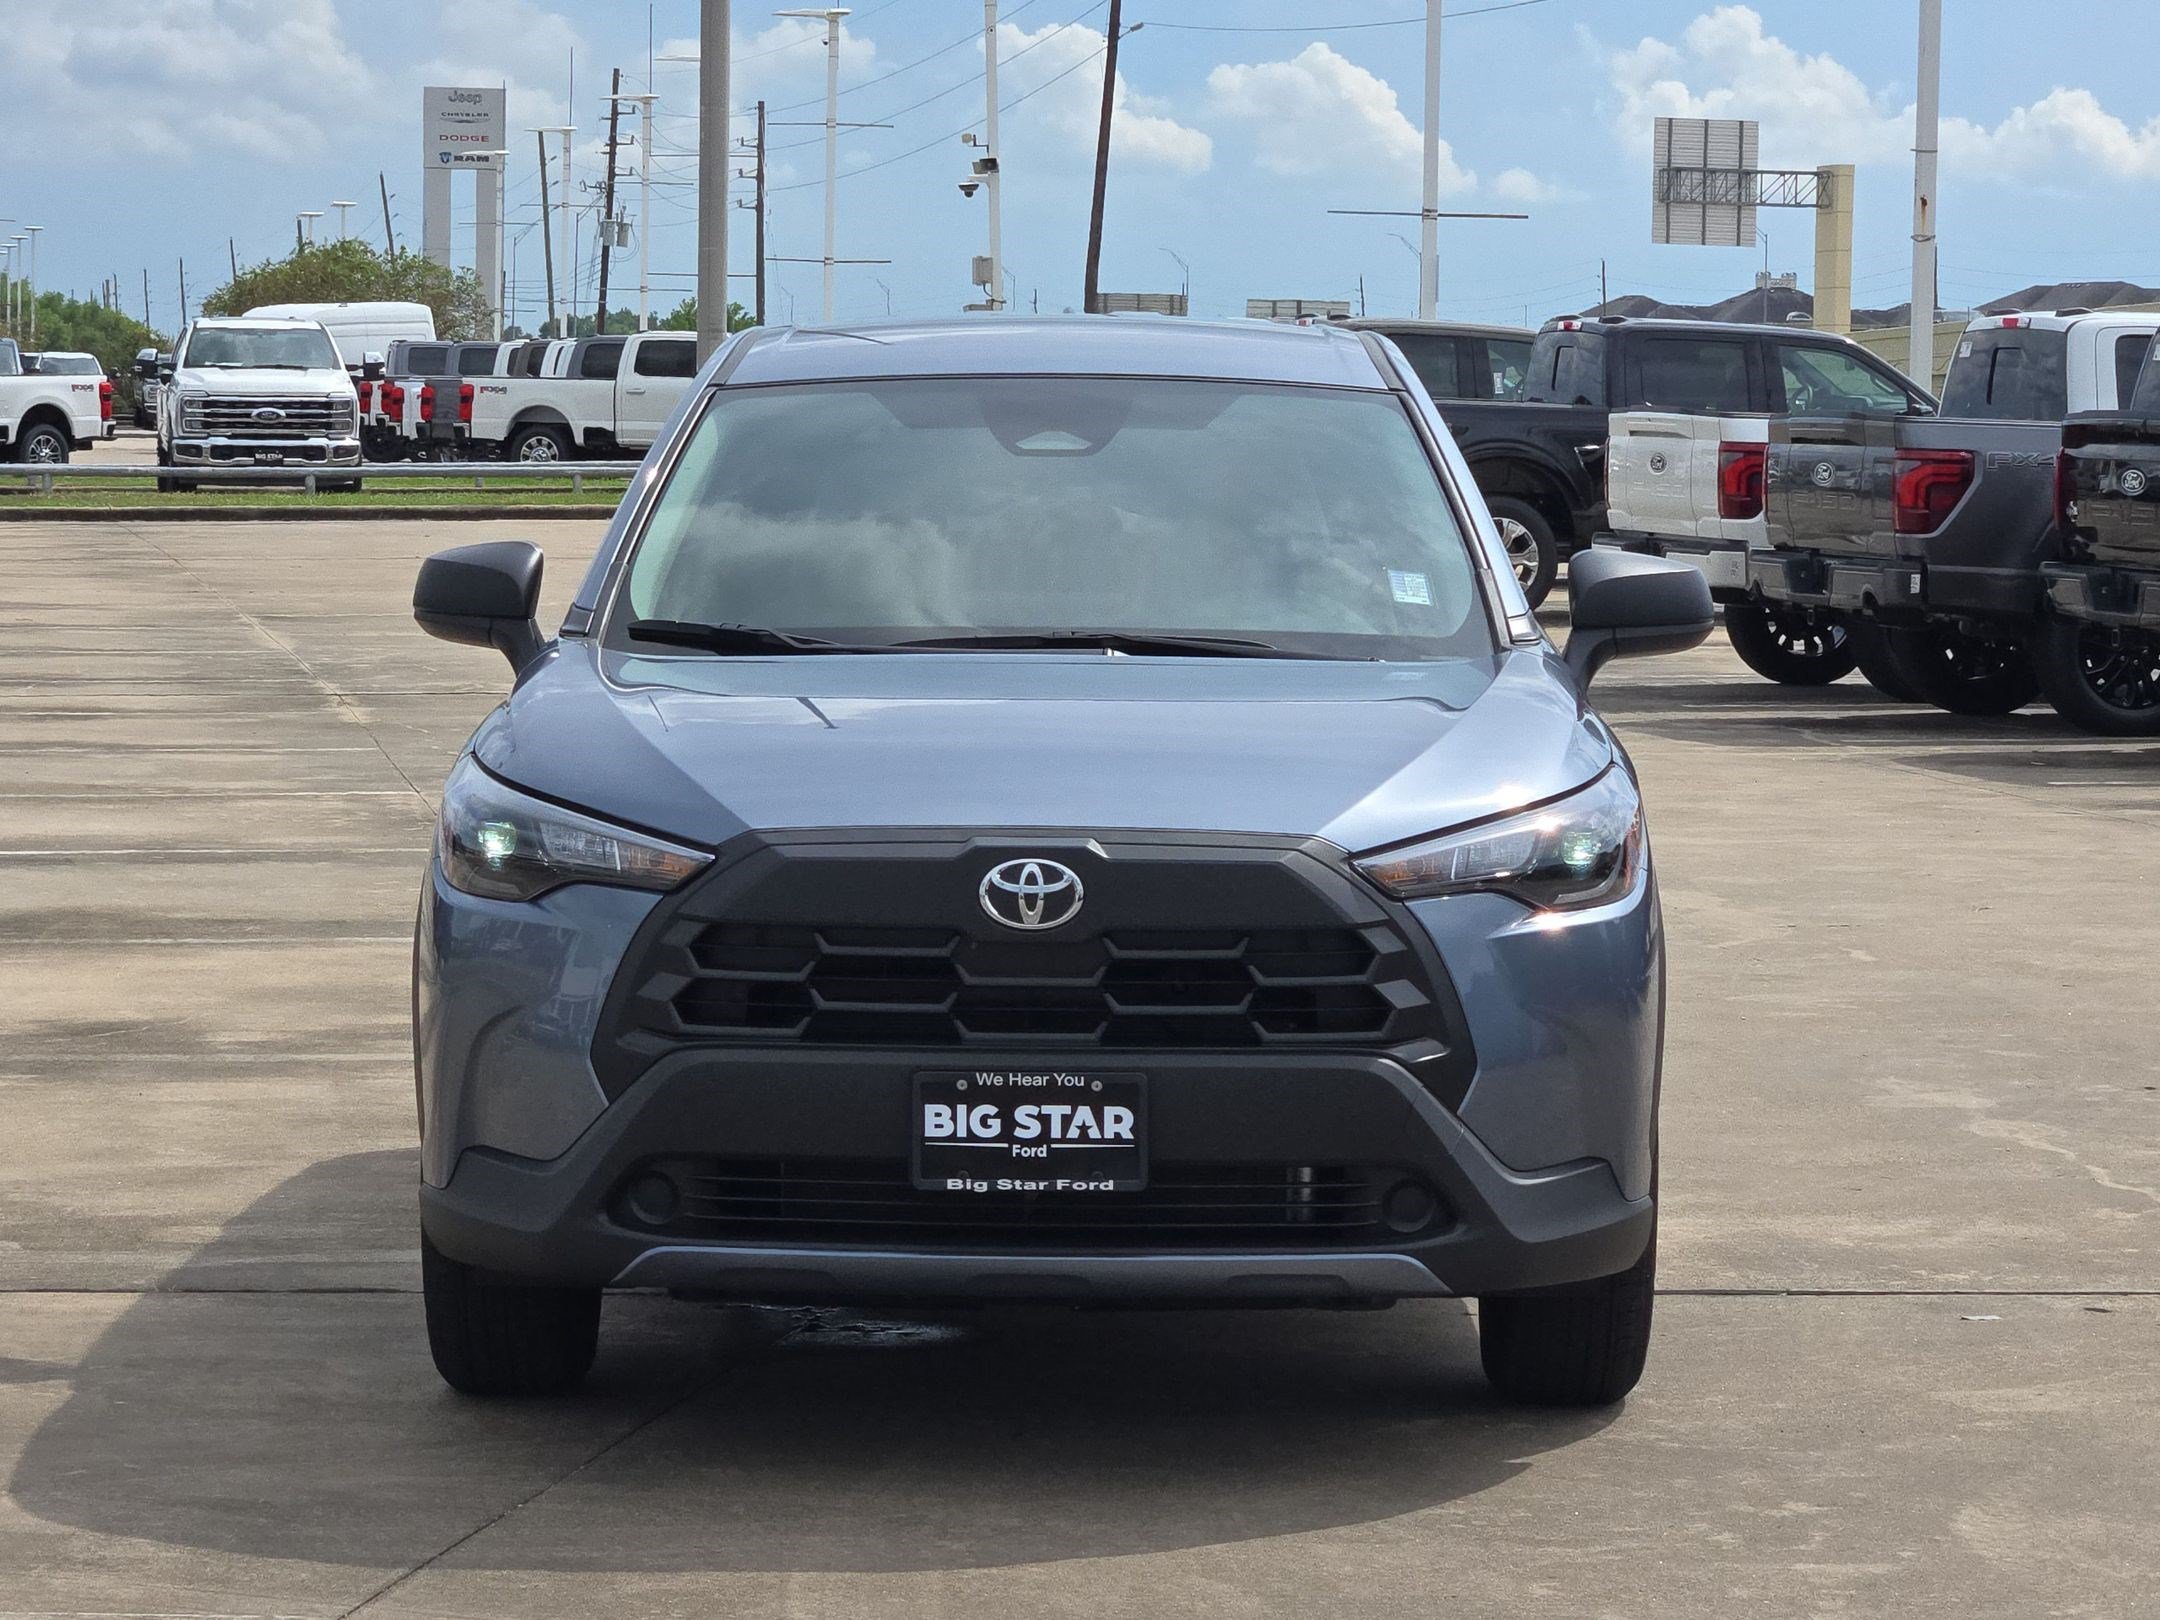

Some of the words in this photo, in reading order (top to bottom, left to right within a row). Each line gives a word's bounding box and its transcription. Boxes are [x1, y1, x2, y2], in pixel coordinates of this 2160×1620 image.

[448, 90, 483, 105] Jeep
[439, 134, 489, 143] DODGE
[453, 154, 490, 163] RAM
[976, 1072, 1003, 1087] We
[1009, 1073, 1050, 1087] Hear
[1053, 1073, 1085, 1087] You
[924, 1104, 1002, 1139] BIG
[1013, 1104, 1135, 1140] STAR
[1012, 1144, 1047, 1158] Ford
[946, 1178, 988, 1192] Big
[996, 1178, 1049, 1191] Star
[1056, 1179, 1115, 1191] Ford
